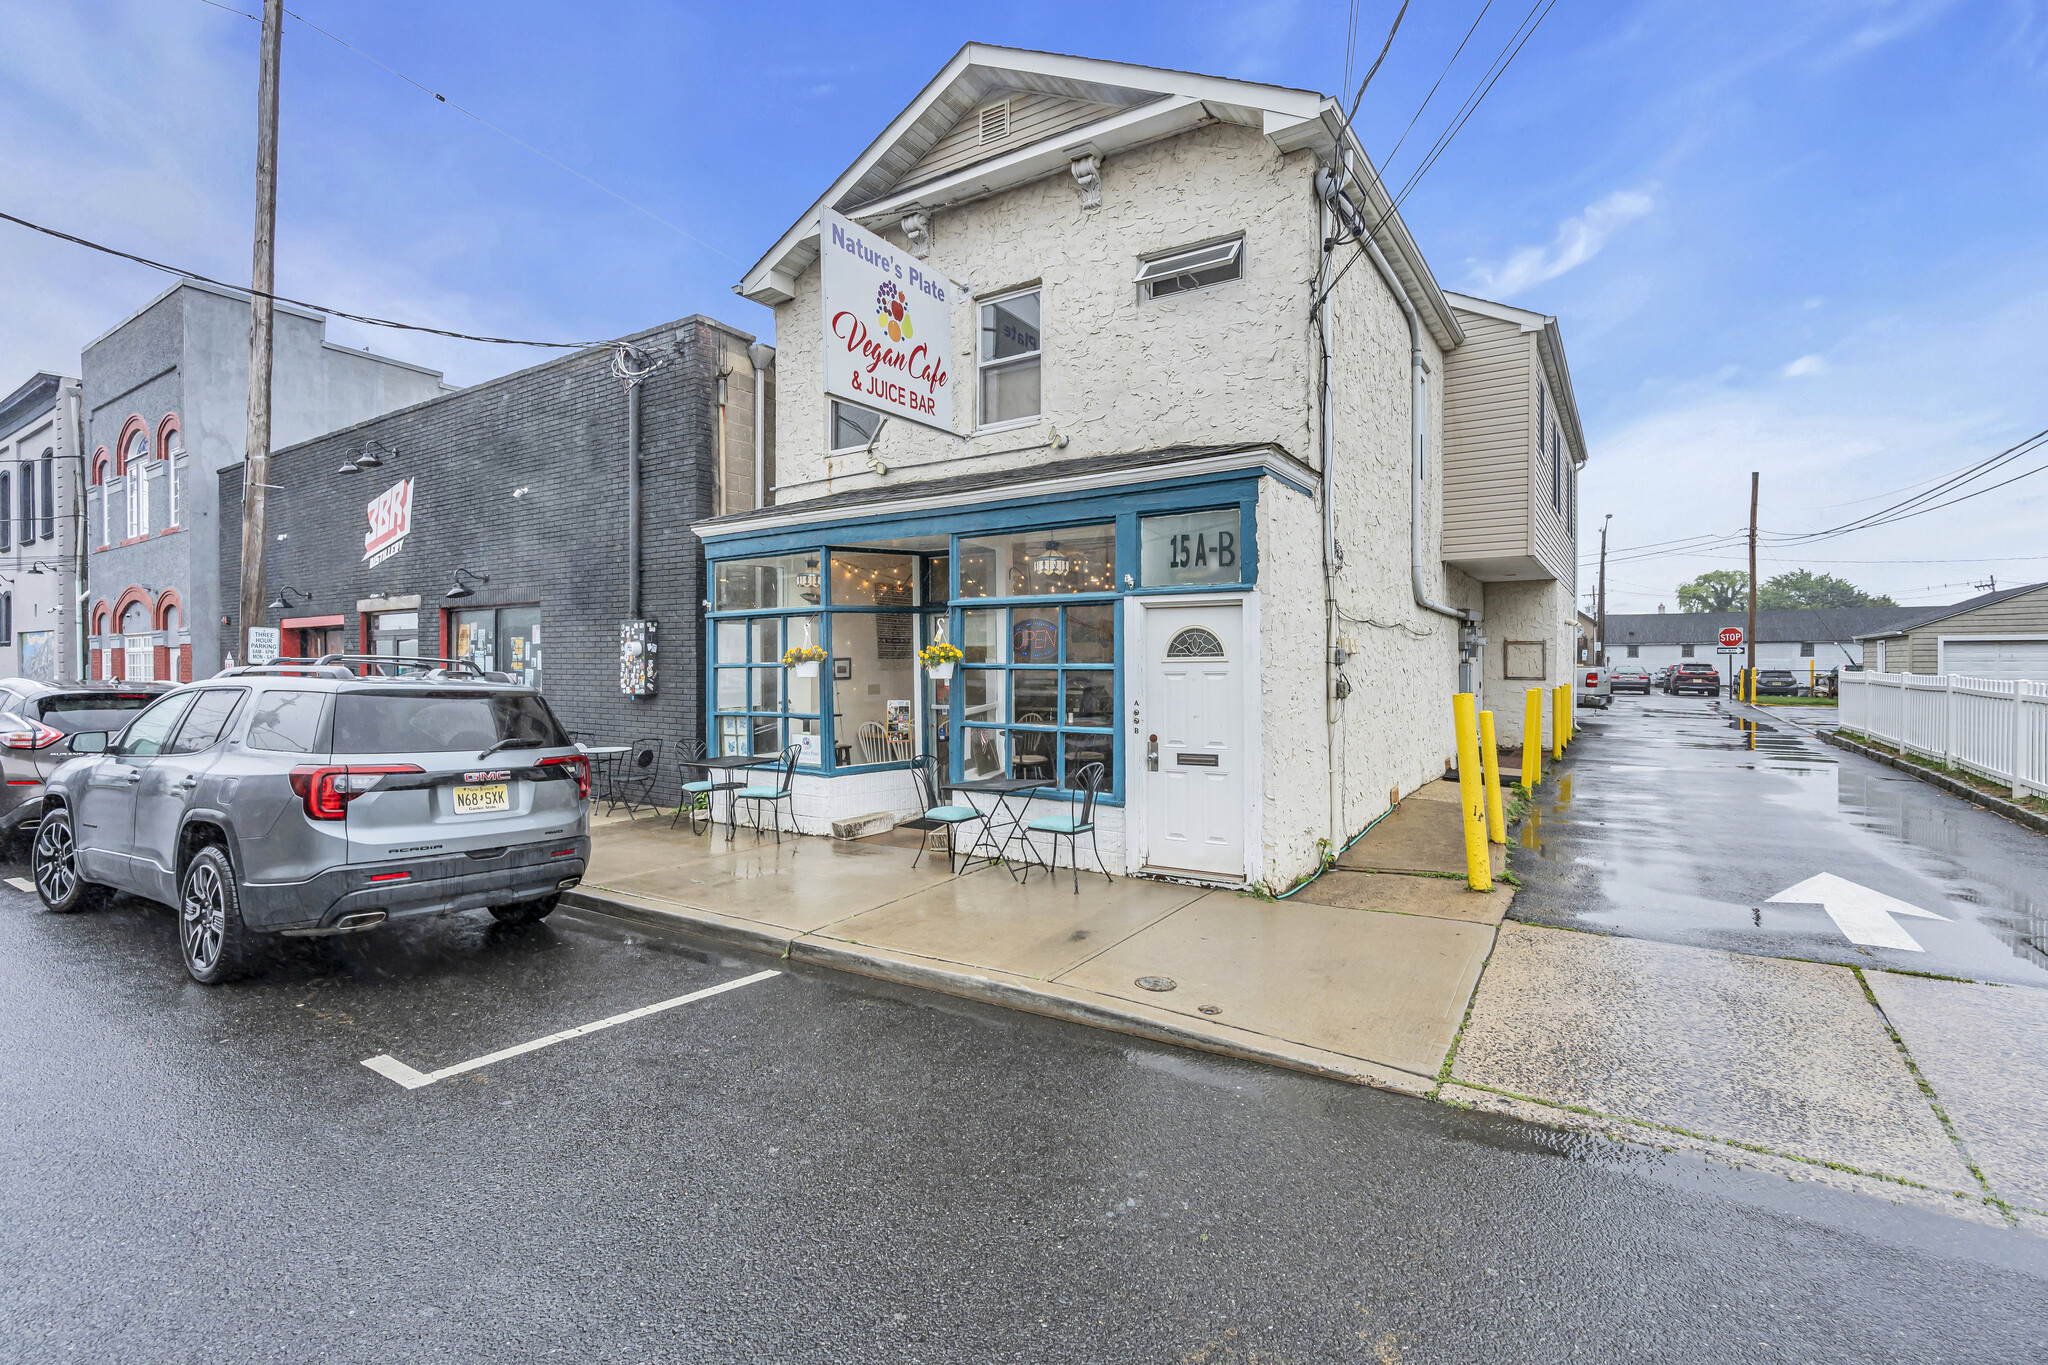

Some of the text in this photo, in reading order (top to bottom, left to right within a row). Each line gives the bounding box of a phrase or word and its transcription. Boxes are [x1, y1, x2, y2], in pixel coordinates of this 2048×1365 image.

[832, 223, 945, 303] Nature's Plate
[832, 311, 949, 394] Vegan Cafe
[851, 370, 936, 416] & JUICE BAR
[369, 538, 405, 569] DISTILLERY
[1013, 628, 1057, 650] OPEN
[1720, 633, 1741, 642] STOP
[464, 770, 511, 783] GMC
[388, 844, 443, 854] ACADIA
